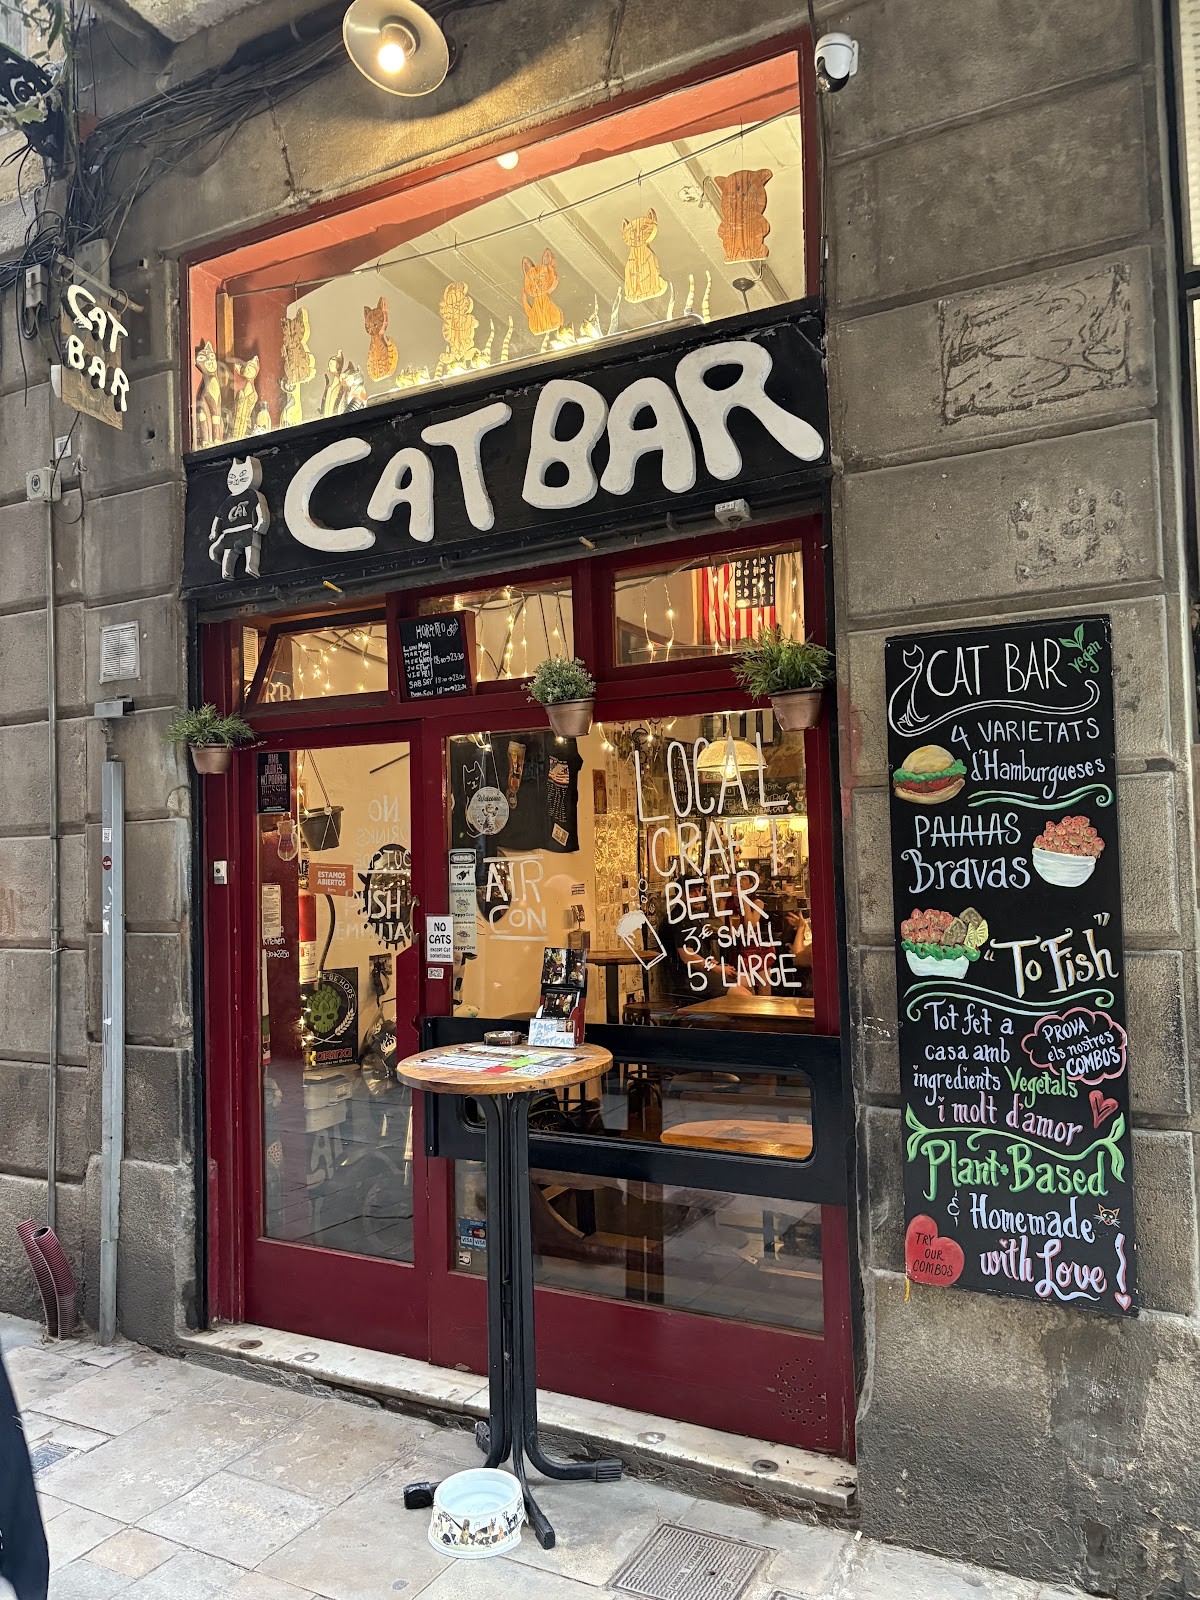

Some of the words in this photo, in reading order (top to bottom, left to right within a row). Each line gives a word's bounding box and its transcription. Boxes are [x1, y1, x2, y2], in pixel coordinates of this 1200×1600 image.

[67, 284, 129, 353] CAT
[67, 334, 130, 412] BAR
[284, 402, 513, 552] CAT
[522, 341, 825, 509] BAR
[228, 501, 249, 522] CAT
[926, 645, 989, 696] CAT
[1005, 638, 1067, 694] BAR
[1067, 640, 1103, 674] vegan
[409, 680, 422, 689] SAB
[951, 724, 970, 751] 4
[977, 718, 1100, 743] VARIETATS
[634, 732, 789, 822] LOCAL
[970, 749, 1106, 799] d'Hamburgueses
[651, 814, 795, 878] CRAFT
[914, 812, 1021, 848] PATATAS
[317, 871, 346, 879] ESTAMOS
[317, 879, 346, 887] ABIERTOS
[486, 859, 544, 905] AIR
[900, 848, 1031, 893] Bravas
[345, 889, 401, 920] PUSH
[665, 870, 769, 925] BEER
[434, 922, 446, 931] NO
[489, 905, 547, 935] CON
[717, 921, 782, 948] SMALL
[429, 935, 452, 944] CATS
[720, 953, 802, 989] LARGE
[924, 998, 959, 1031] Tot
[962, 1003, 992, 1035] fet
[1000, 1016, 1014, 1035] a
[1042, 1017, 1089, 1044] PROVA
[924, 1044, 968, 1061] casa
[973, 1037, 1010, 1063] amb
[1047, 1043, 1066, 1063] els
[1067, 1030, 1114, 1056] nostres
[1066, 1045, 1121, 1077] COMBOS
[912, 1064, 1001, 1106] ingredients
[1004, 1066, 1079, 1109] Vegetals
[952, 1091, 997, 1124] molt
[1005, 1093, 1083, 1146] d'amor
[969, 1192, 1095, 1244] Homemade
[915, 1232, 935, 1246] TRY
[924, 1248, 945, 1261] OUR
[912, 1260, 954, 1276] COMBOS
[979, 1235, 1034, 1283] with
